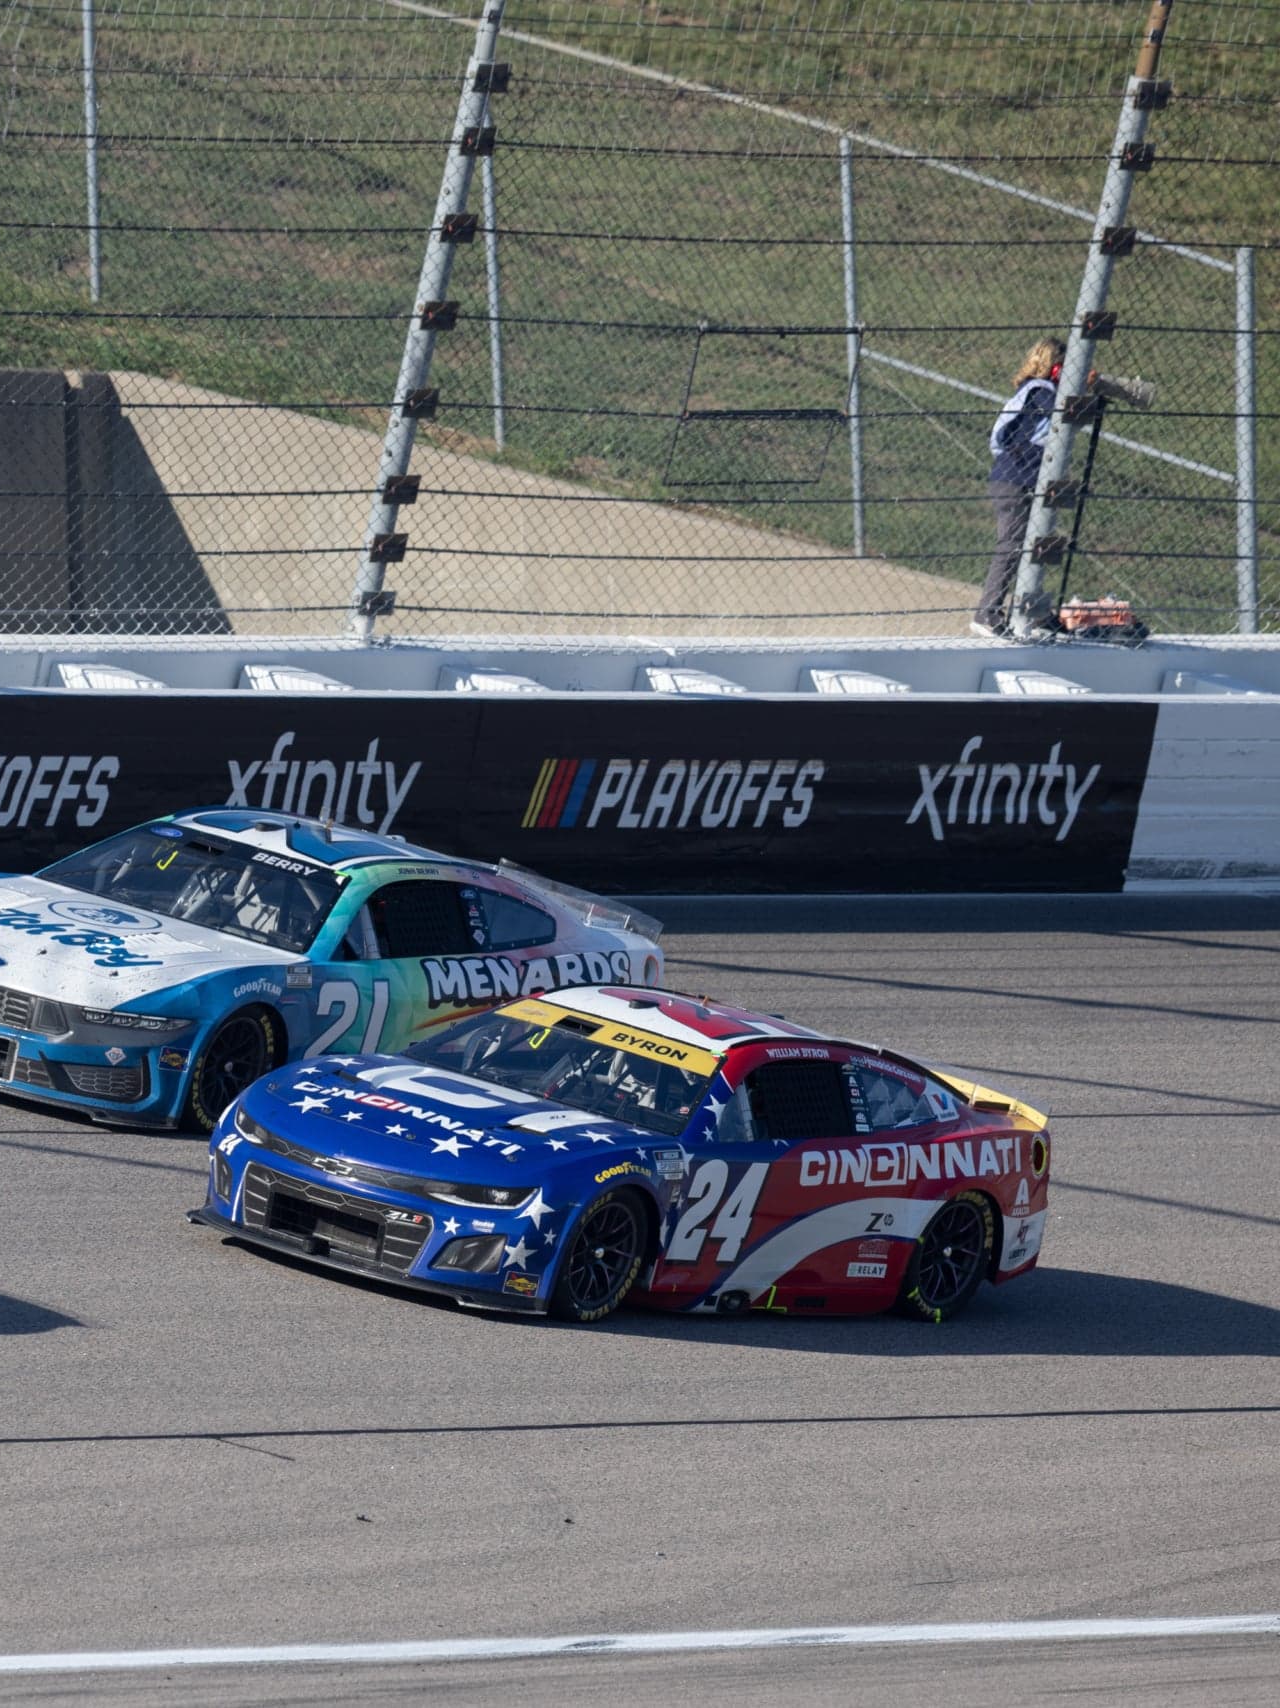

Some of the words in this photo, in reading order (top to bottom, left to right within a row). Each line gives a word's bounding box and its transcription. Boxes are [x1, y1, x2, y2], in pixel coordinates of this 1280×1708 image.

[224, 731, 422, 836] xfinity
[586, 759, 825, 828] PLAYOFFS
[905, 735, 1101, 841] xfinity
[251, 851, 319, 876] BERRY
[233, 978, 283, 998] GOODYEAR
[422, 952, 631, 1008] MENARDS
[303, 979, 390, 1060] 21
[611, 1032, 688, 1062] BYRON
[765, 1048, 800, 1058] WILLIAM
[802, 1047, 830, 1059] BYRON
[292, 1081, 524, 1156] CINCINNATI
[594, 1161, 652, 1183] GOODYEAR
[800, 1137, 1021, 1186] CINCINNATI
[665, 1159, 771, 1262] 24
[857, 1265, 885, 1275] RELAY
